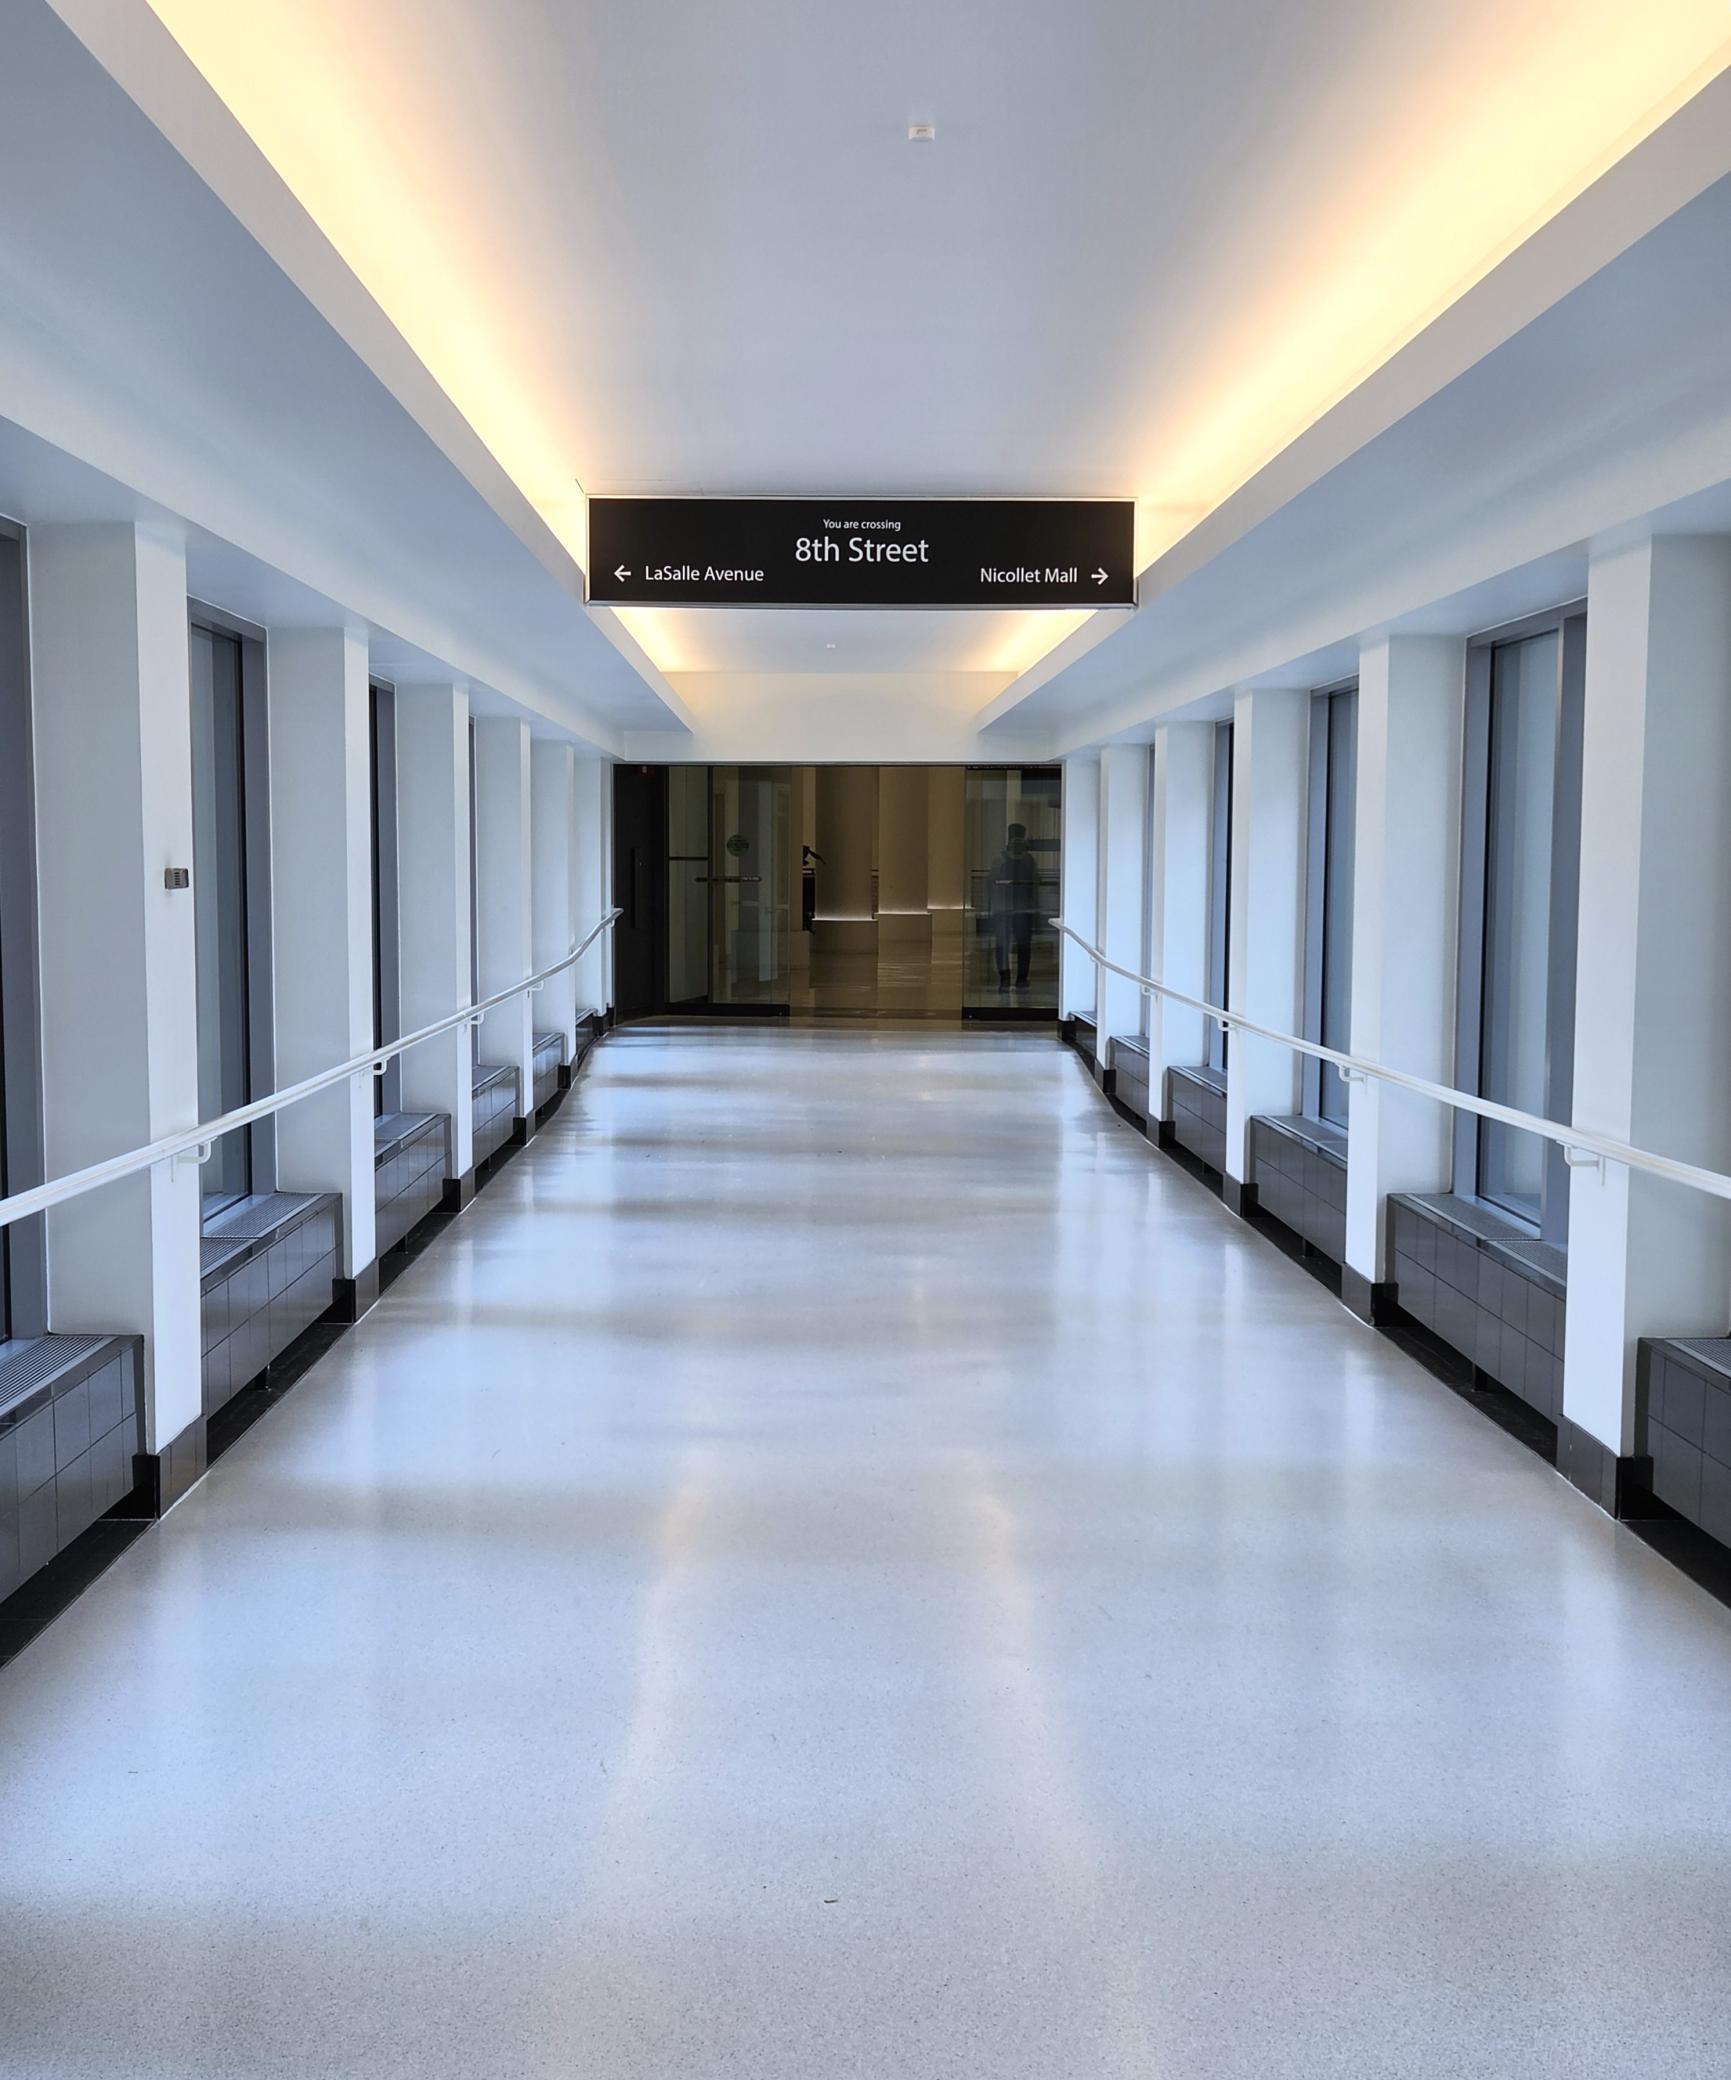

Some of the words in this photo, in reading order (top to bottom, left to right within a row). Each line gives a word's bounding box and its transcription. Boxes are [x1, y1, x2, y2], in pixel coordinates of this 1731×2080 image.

[822, 518, 842, 530] You
[843, 521, 860, 530] are
[860, 519, 901, 532] crossing
[795, 536, 840, 562] 8th
[848, 536, 929, 563] Street
[645, 564, 700, 582] LaSalle
[703, 564, 765, 582] Avenue
[980, 566, 1041, 583] Nicollet
[1044, 566, 1078, 583] Mall
